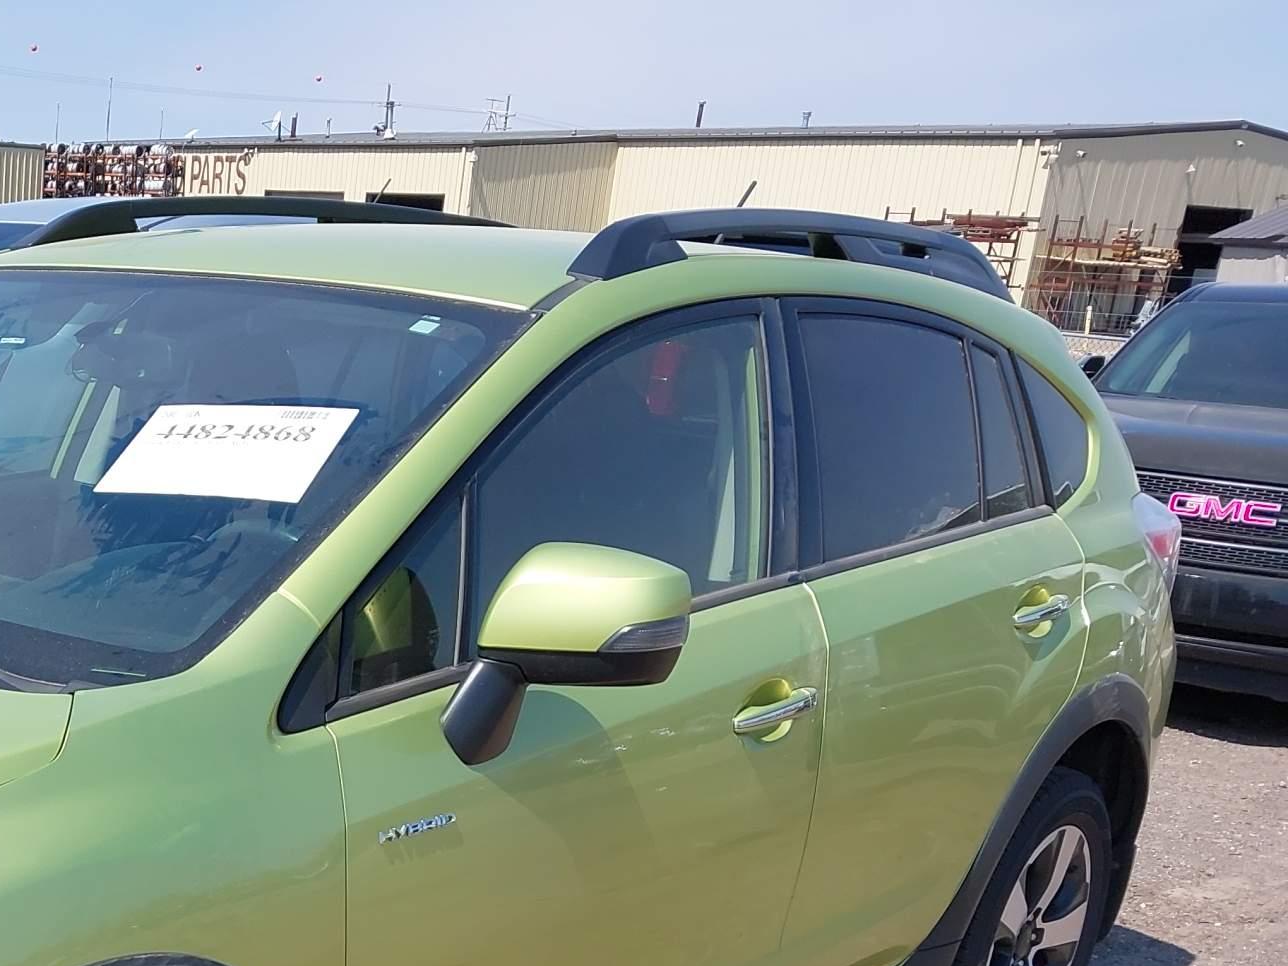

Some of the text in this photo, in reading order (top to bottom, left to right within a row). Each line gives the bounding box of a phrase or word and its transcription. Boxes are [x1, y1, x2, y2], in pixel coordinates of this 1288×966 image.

[189, 154, 247, 195] PARTS
[156, 423, 317, 443] 44824868
[1168, 492, 1281, 526] GMC
[379, 813, 456, 844] HYBRID
